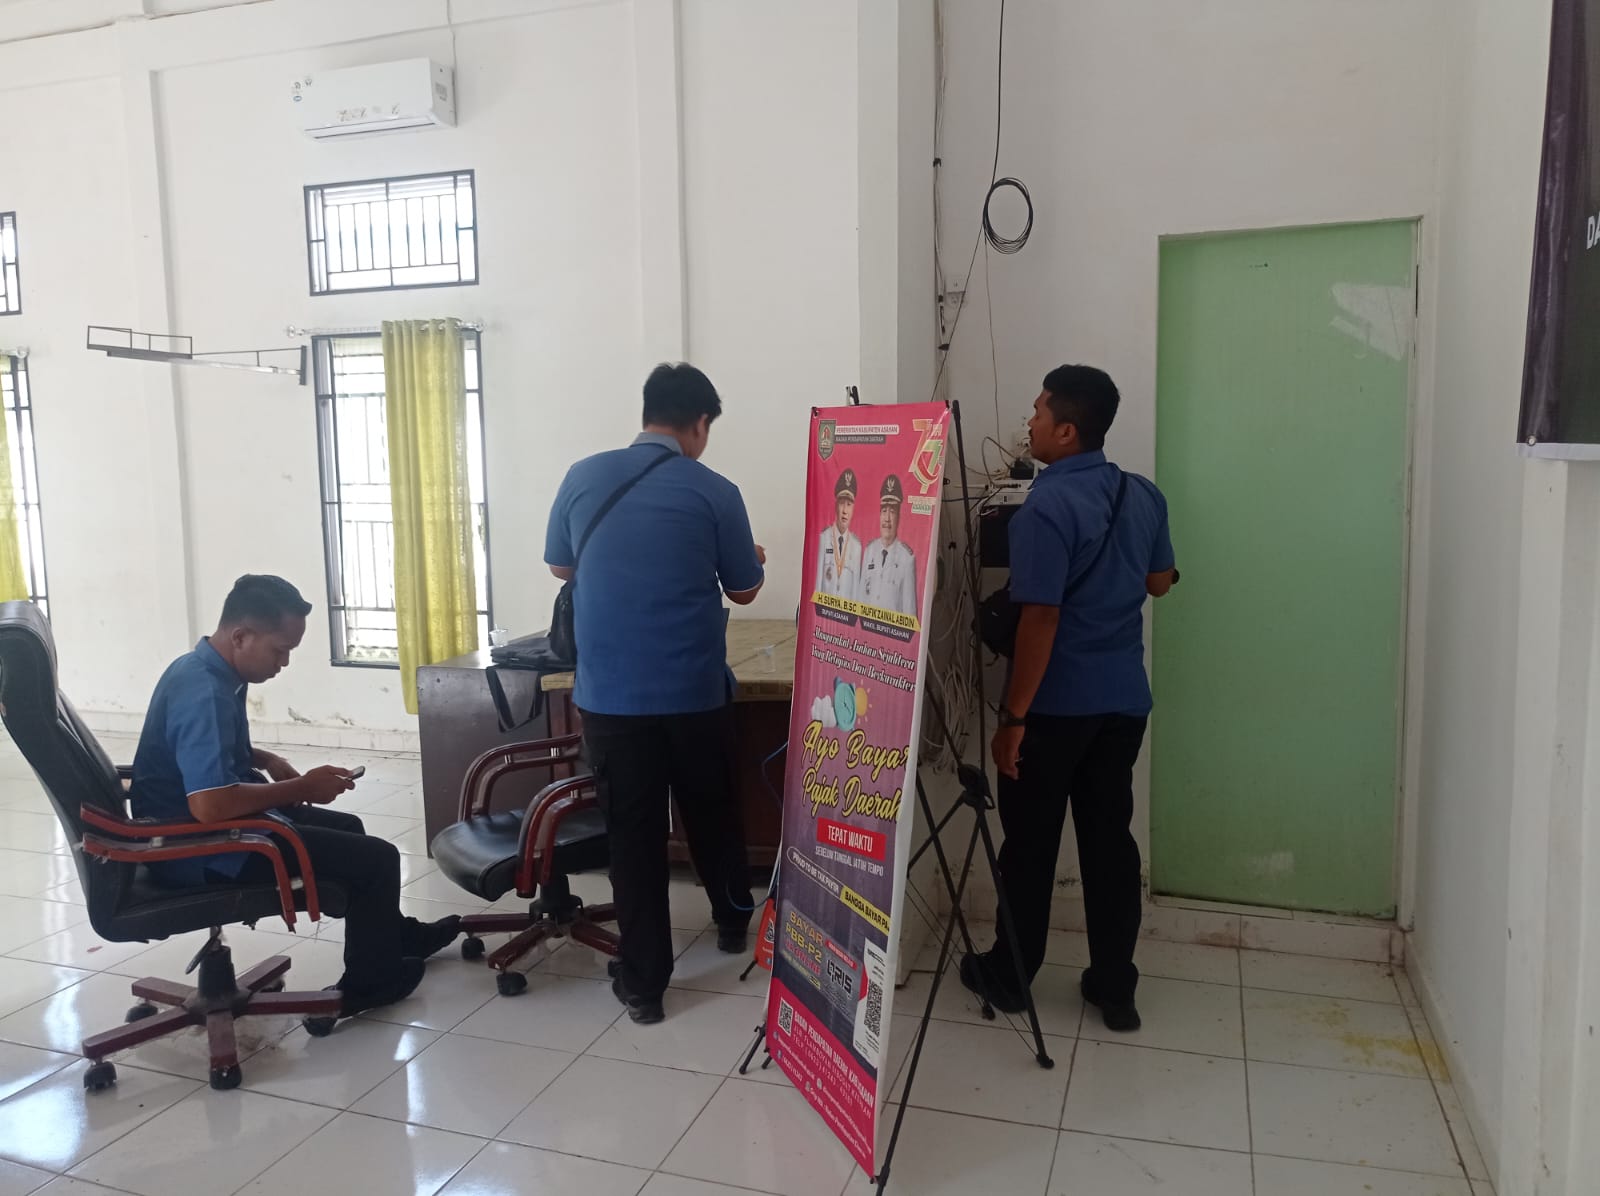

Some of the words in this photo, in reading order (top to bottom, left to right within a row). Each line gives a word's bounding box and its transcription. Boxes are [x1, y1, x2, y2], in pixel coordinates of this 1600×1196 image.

[834, 612, 849, 622] ASAHAN
[860, 605, 877, 618] TAUFIK
[877, 609, 895, 623] ZAINAL
[895, 615, 915, 628] ABIDIN
[863, 621, 876, 630] WAKIL
[876, 624, 890, 635] BUPATI
[890, 628, 909, 639] ASAHAN
[811, 642, 825, 662] Yang
[825, 650, 851, 670] Religius
[851, 659, 867, 675] Dan
[867, 663, 916, 693] Berkarakter
[876, 647, 915, 671] Sejahtera
[801, 719, 840, 772] Ayo
[846, 728, 910, 783] Bayar
[802, 767, 839, 819] Pajak
[841, 775, 903, 823] Daerah
[828, 825, 848, 846] TEPAT
[848, 830, 873, 852] WAKTU
[805, 863, 811, 873] TO
[810, 865, 817, 877] BE
[817, 870, 826, 882] TAX
[815, 845, 834, 859] SEBELUM
[854, 858, 867, 872] JATUH
[867, 862, 883, 876] TEMPO
[845, 891, 865, 912] BANGGA
[864, 906, 881, 923] BAYAR
[789, 911, 823, 946] BAYAR
[826, 959, 853, 994] QRIS
[807, 1025, 833, 1058] PENDAPATAN
[832, 1050, 849, 1076] DAERAH
